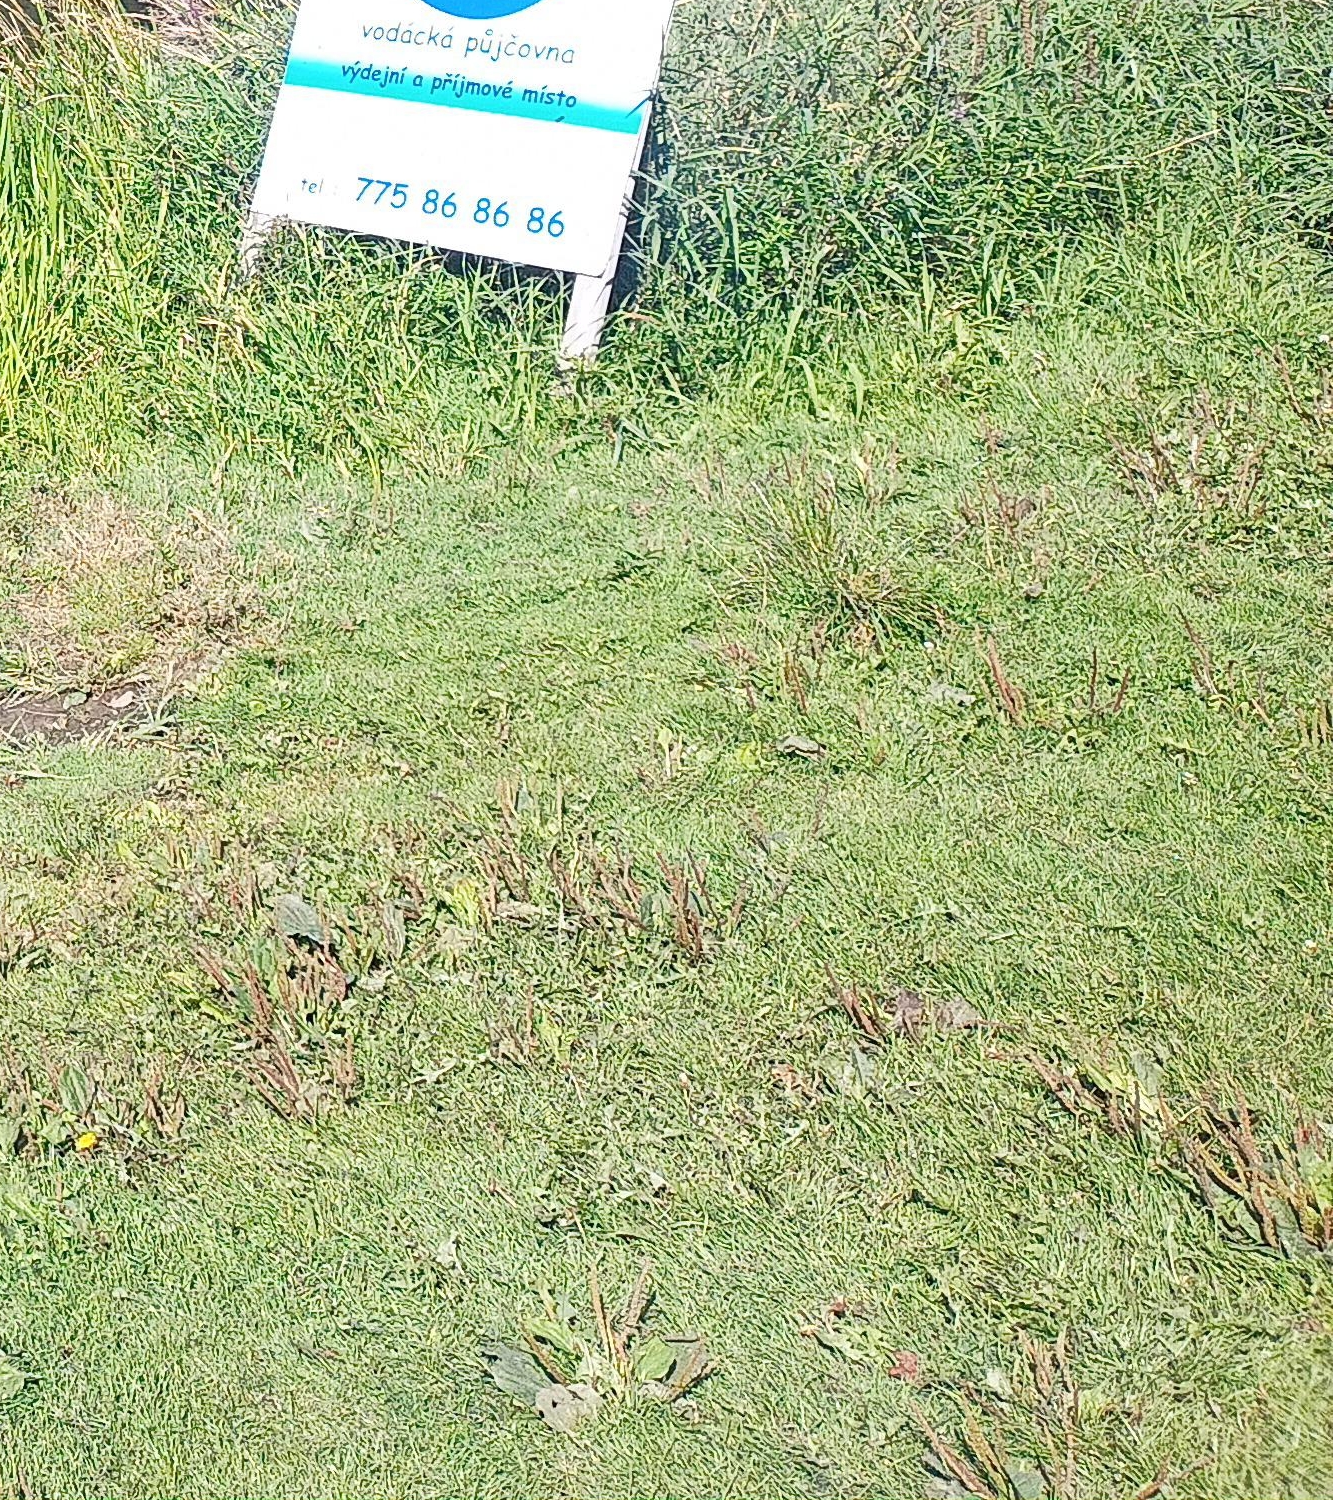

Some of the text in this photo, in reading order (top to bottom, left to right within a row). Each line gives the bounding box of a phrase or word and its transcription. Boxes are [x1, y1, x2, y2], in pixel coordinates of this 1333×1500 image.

[361, 22, 575, 64] vodácká půjčovna
[341, 60, 578, 108] výdejní a příjmové místo
[355, 176, 409, 209] 775
[421, 188, 459, 219] 86
[472, 197, 511, 228] 86
[526, 206, 566, 238] 86
